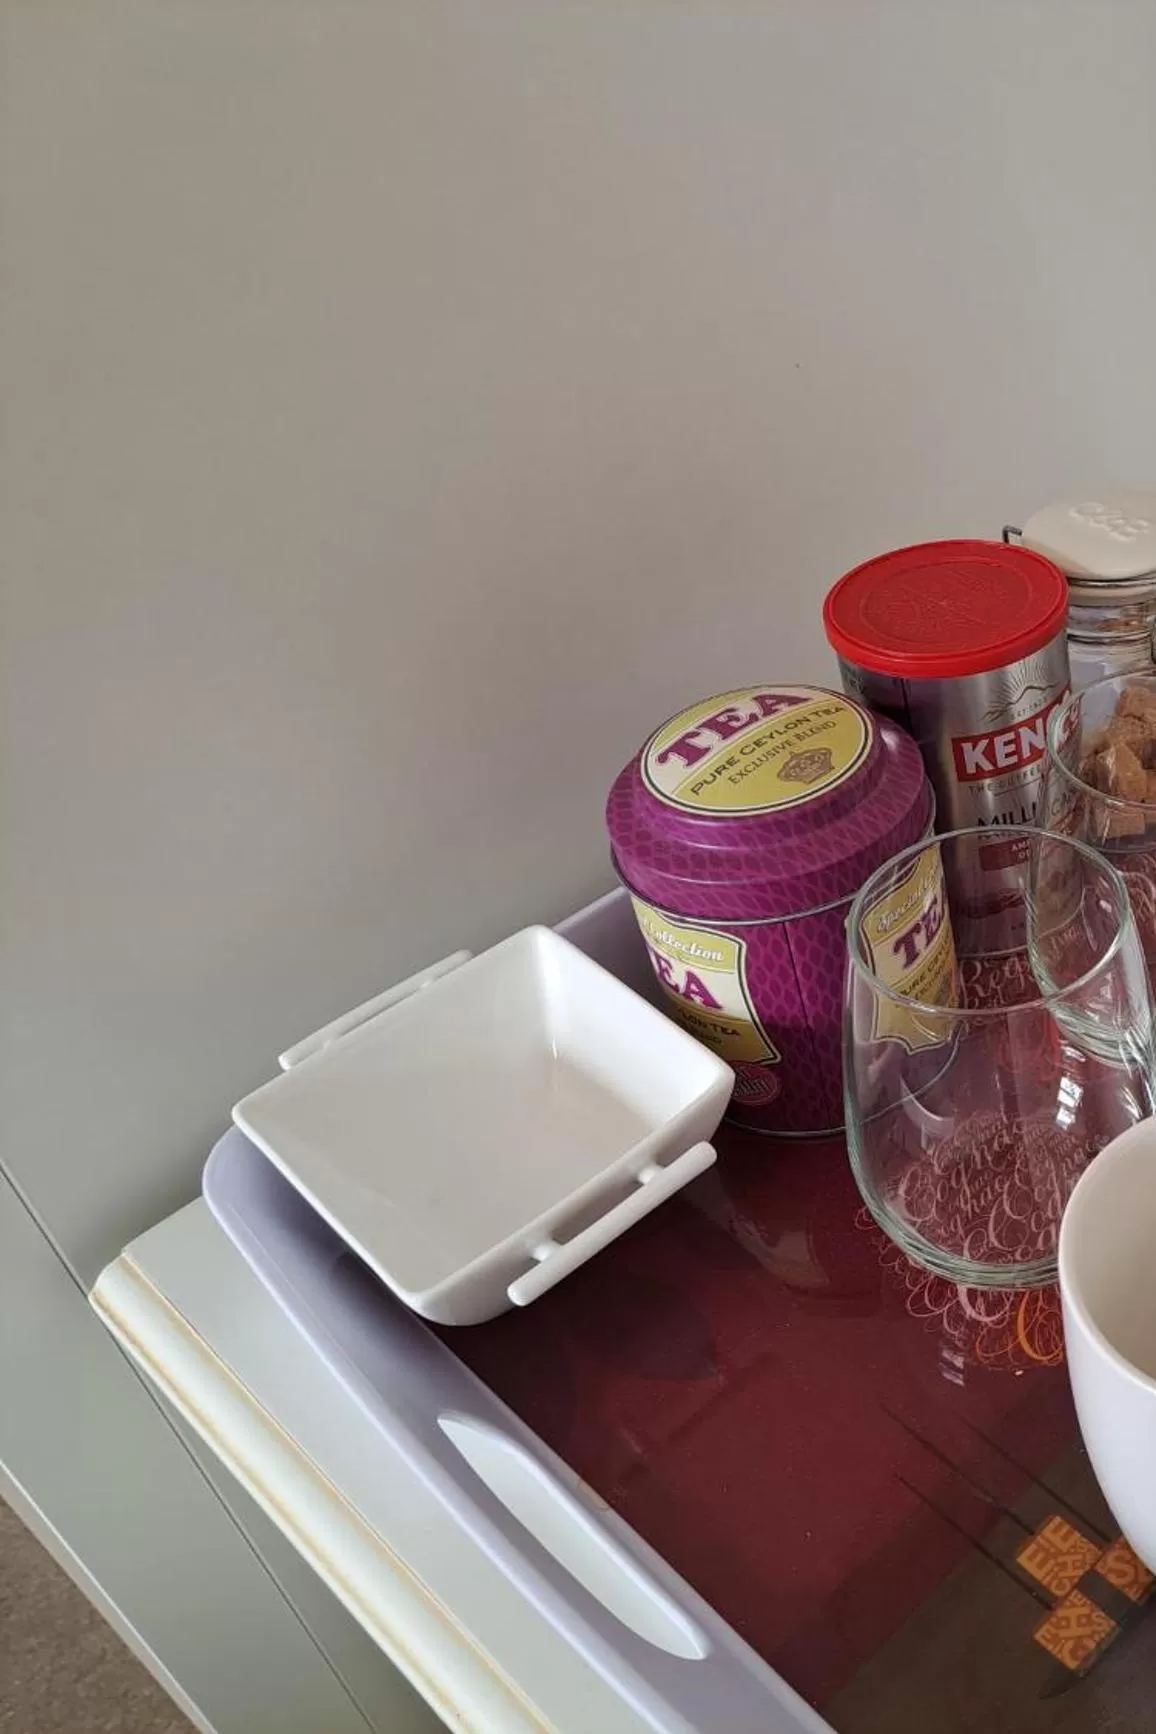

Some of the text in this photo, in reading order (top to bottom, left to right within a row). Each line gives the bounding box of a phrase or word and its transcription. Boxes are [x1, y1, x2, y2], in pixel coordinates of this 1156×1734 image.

[656, 694, 814, 768] TEA
[690, 705, 845, 796] PURE CEYLON TEA
[727, 720, 837, 785] EXCLUSIVE BLEND
